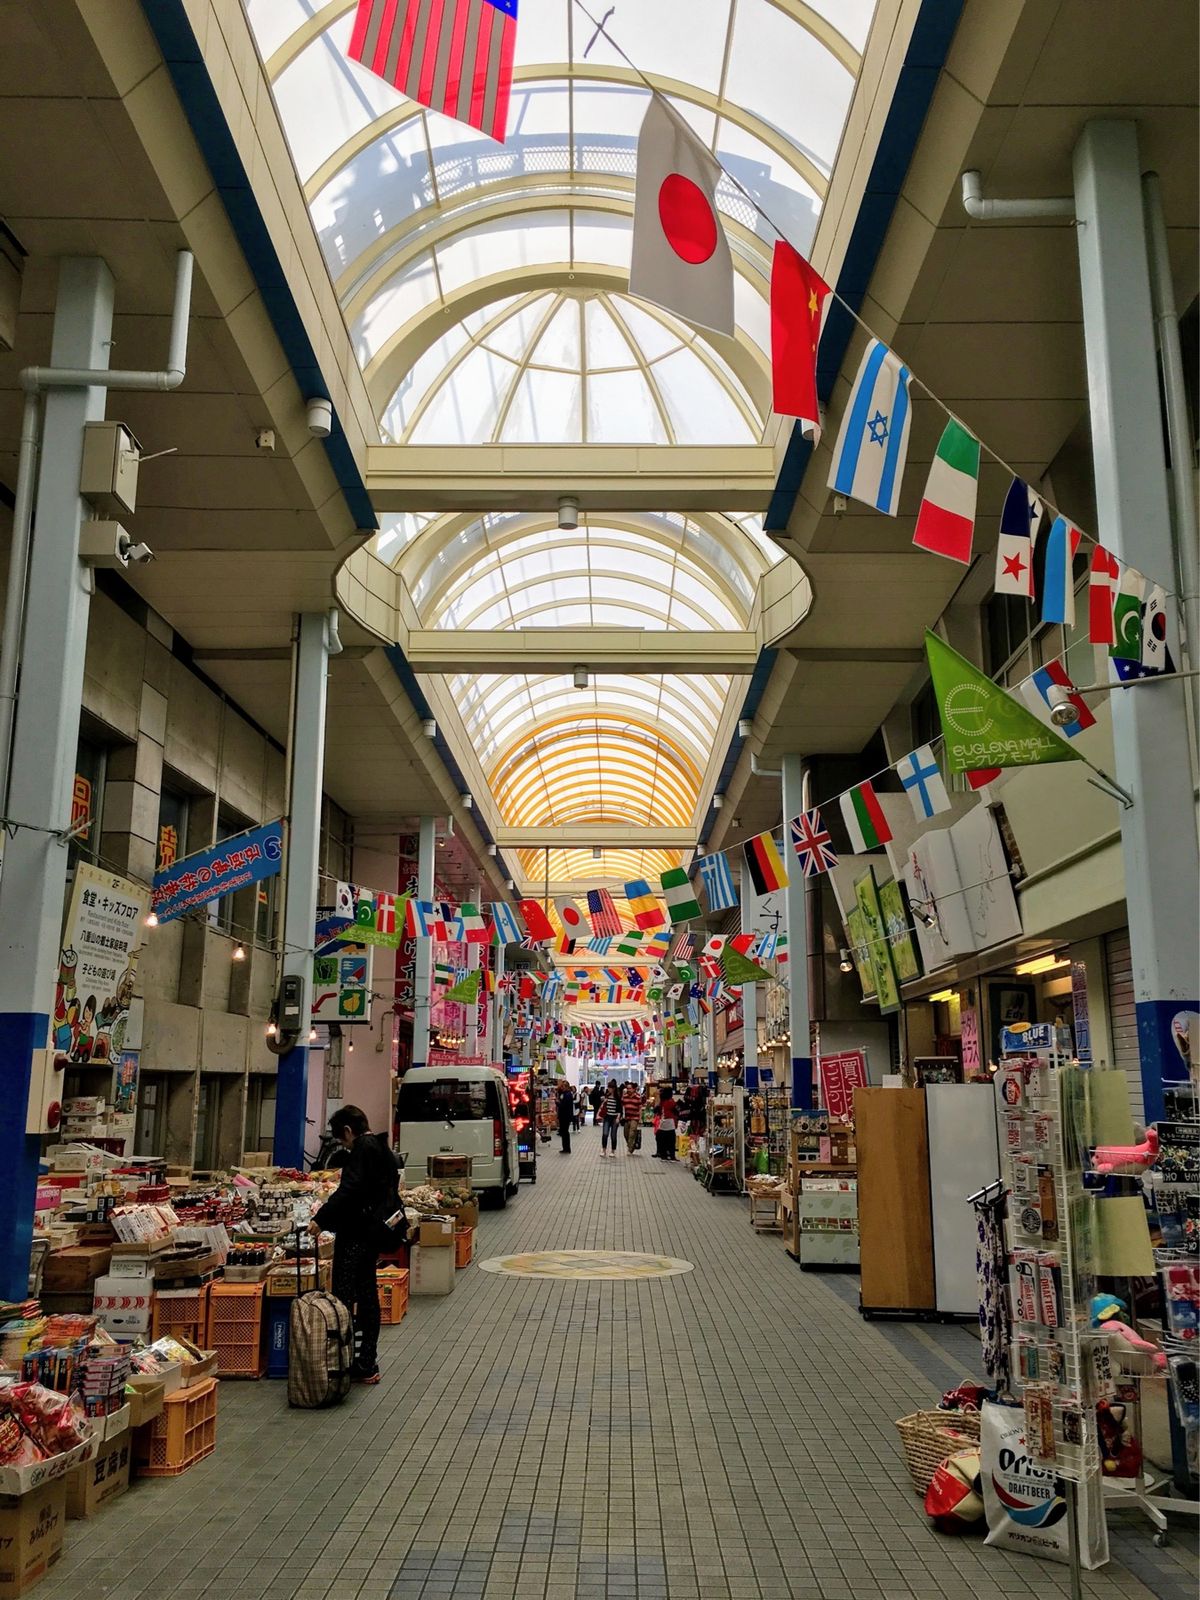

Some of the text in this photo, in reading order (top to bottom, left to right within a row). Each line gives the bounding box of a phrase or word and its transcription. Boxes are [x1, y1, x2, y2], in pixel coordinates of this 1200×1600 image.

[1020, 736, 1057, 750] MALL
[82, 889, 139, 919] 食堂・キッズフロア
[1022, 1026, 1045, 1043] BLUE
[1008, 1482, 1051, 1499] DRAFT BEER
